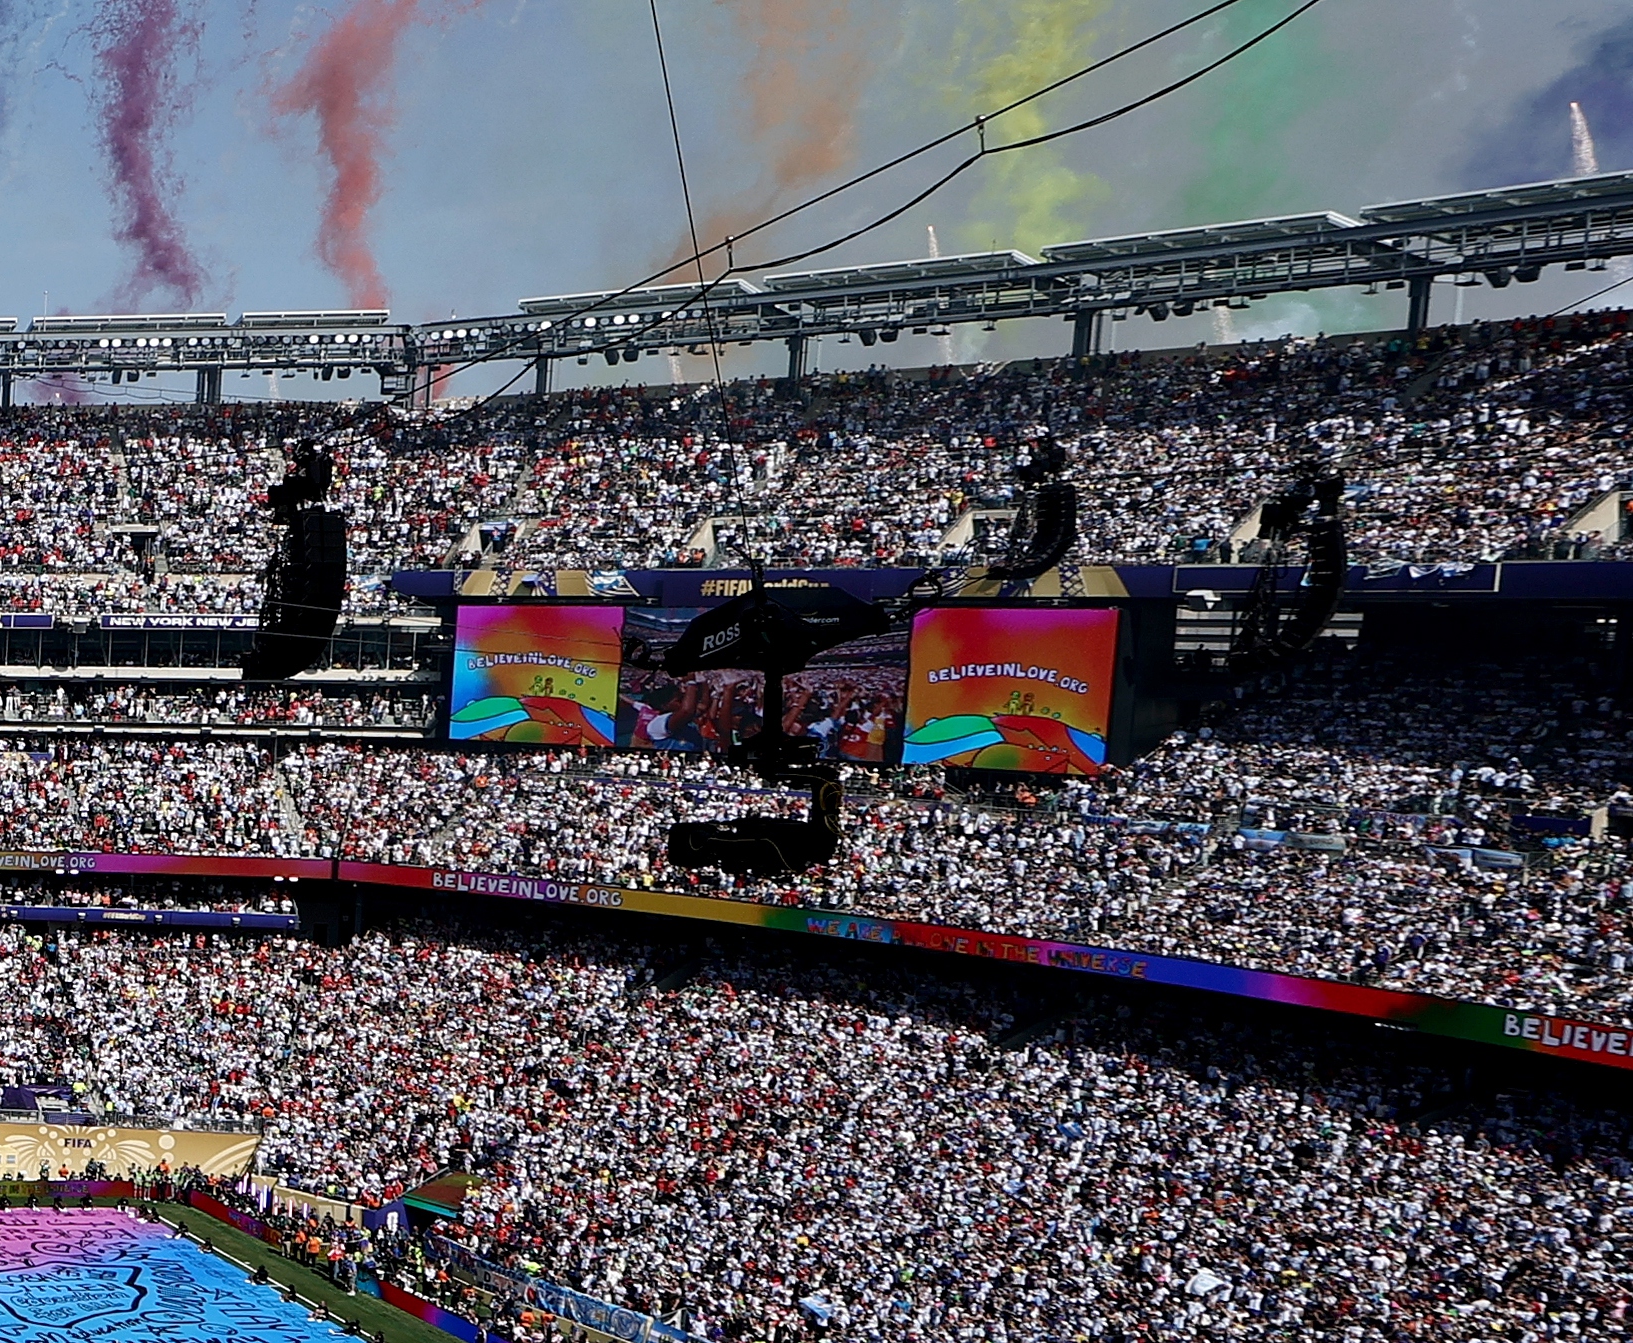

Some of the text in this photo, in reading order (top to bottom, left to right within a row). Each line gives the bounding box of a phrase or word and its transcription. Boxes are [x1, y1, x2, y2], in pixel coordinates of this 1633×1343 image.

[109, 617, 145, 627] NEW
[148, 617, 194, 627] YORK
[195, 617, 233, 627] NEW
[702, 622, 741, 652] ROSS
[466, 651, 598, 679] BELIEVEINLOVE.ORG
[927, 661, 1090, 695] BELIEVEINLOVE.ORG
[432, 871, 623, 907] BELIEVEINLOVE.ORG
[805, 917, 841, 936] WE
[64, 1137, 93, 1149] FIFA
